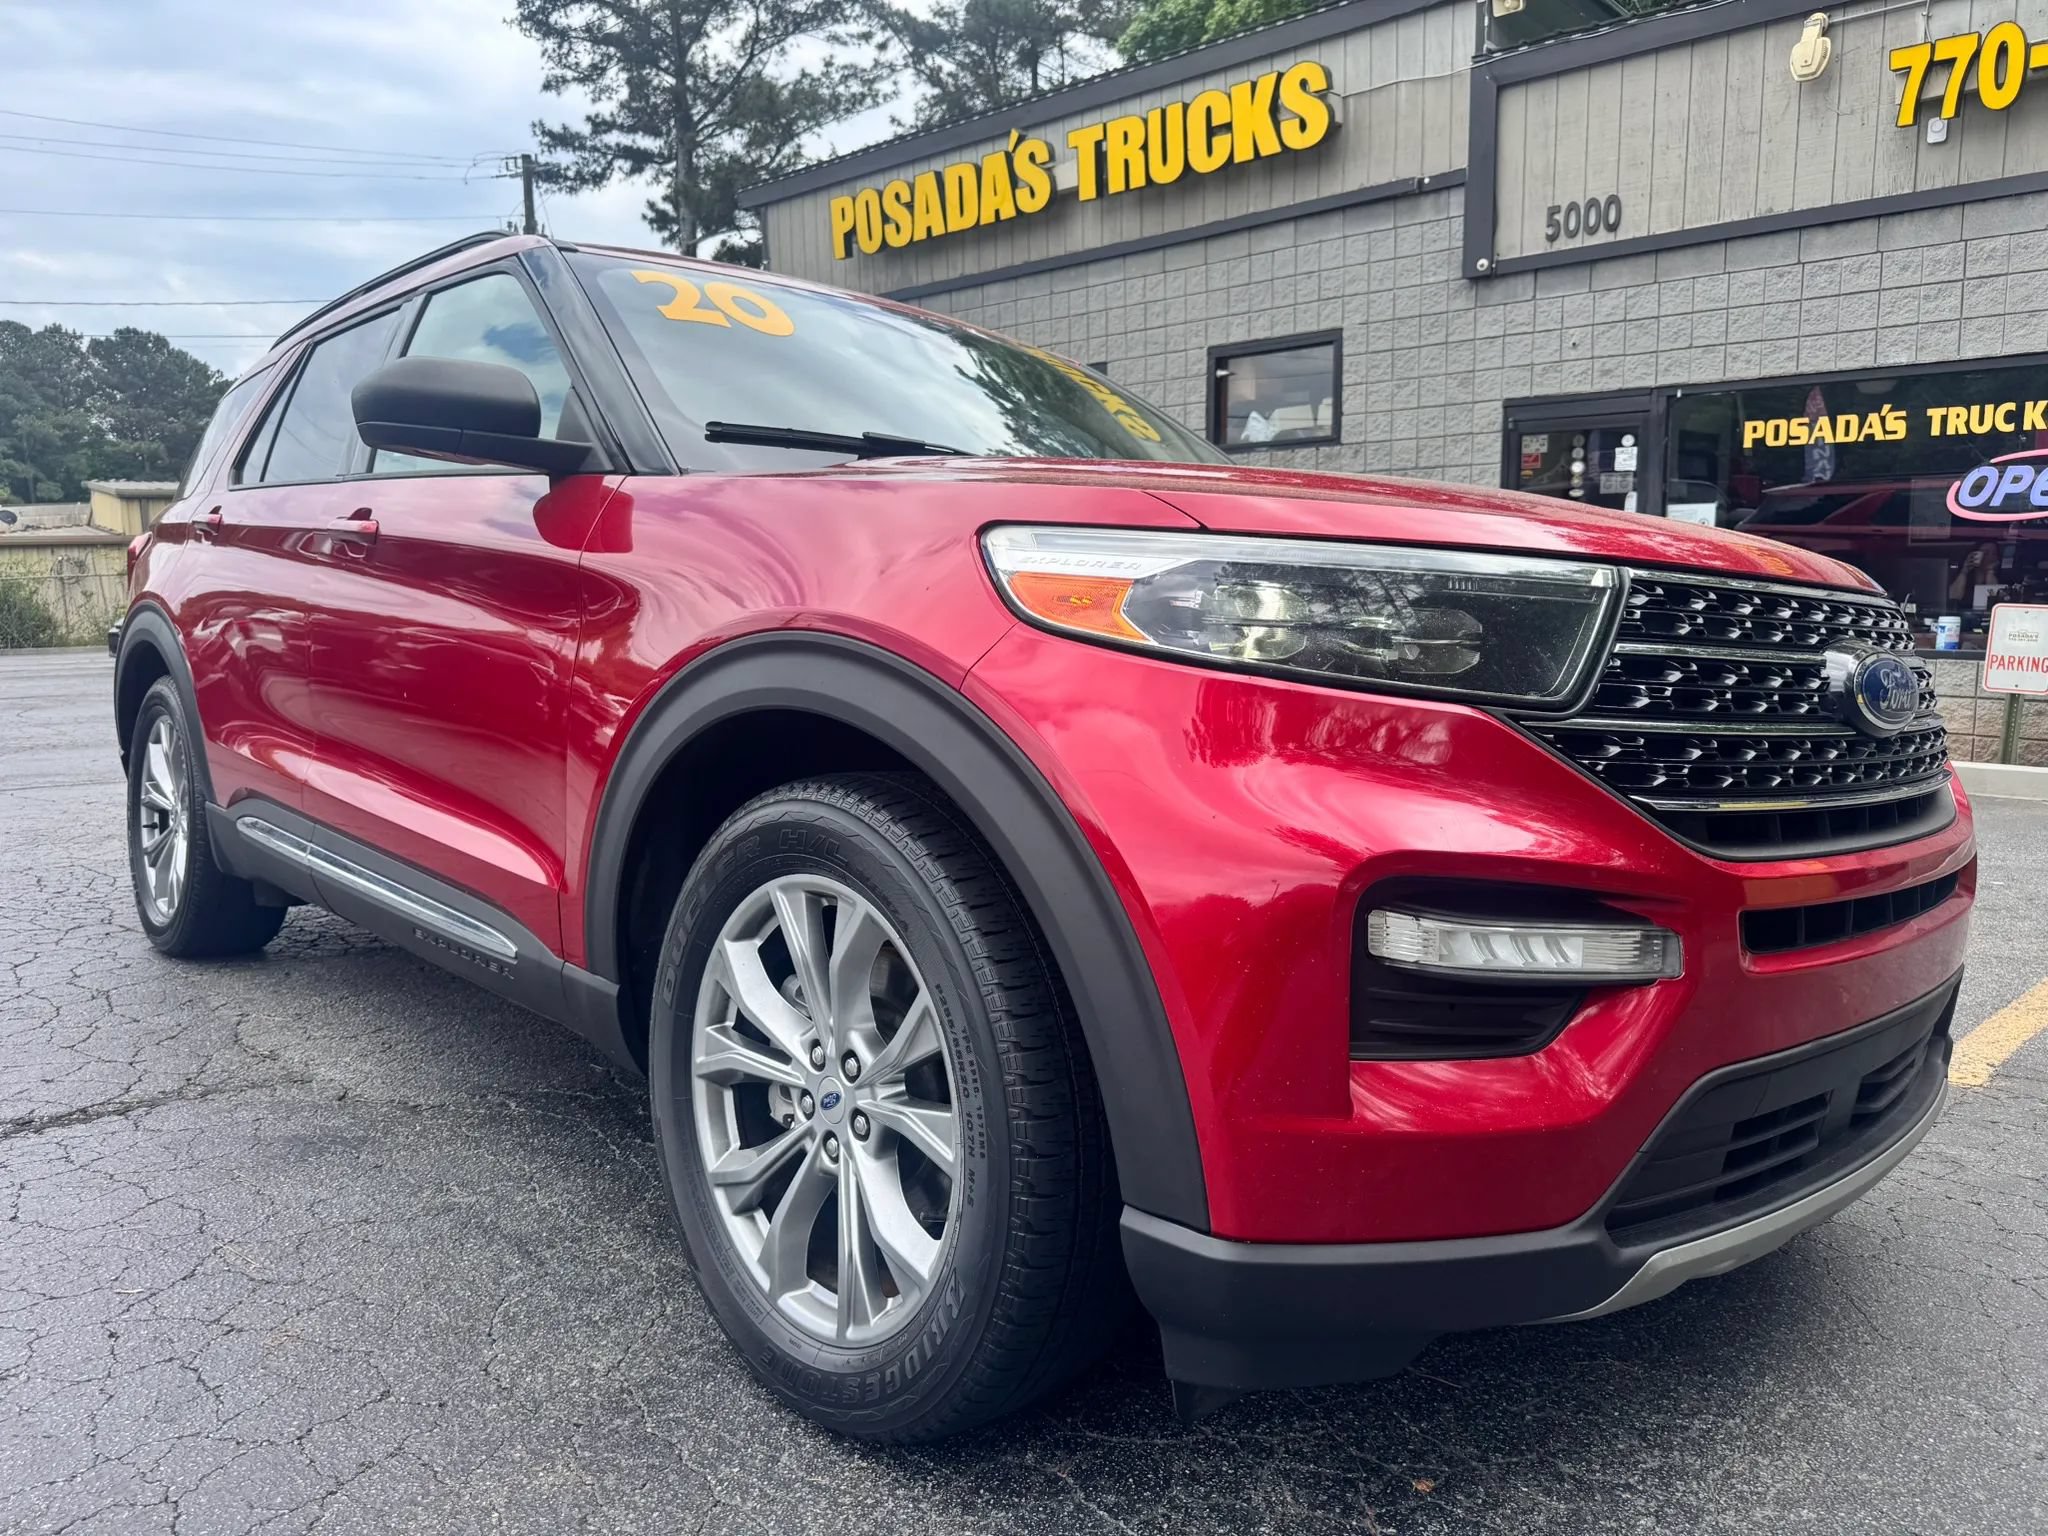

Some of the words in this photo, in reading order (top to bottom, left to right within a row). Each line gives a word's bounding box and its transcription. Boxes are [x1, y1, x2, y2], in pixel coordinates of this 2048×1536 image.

[830, 128, 1055, 260] POSADA'S
[1067, 61, 1332, 202] TRUCKS
[1545, 194, 1622, 243] 5000
[631, 269, 795, 337] 20
[1743, 404, 1907, 449] POSADA'S
[1018, 556, 1142, 571] EXPLORER
[1880, 666, 1914, 710] Ford
[1990, 654, 2048, 674] PARKING
[413, 927, 515, 980] EXPLORER
[760, 1267, 966, 1403] BRIDGESTONE
